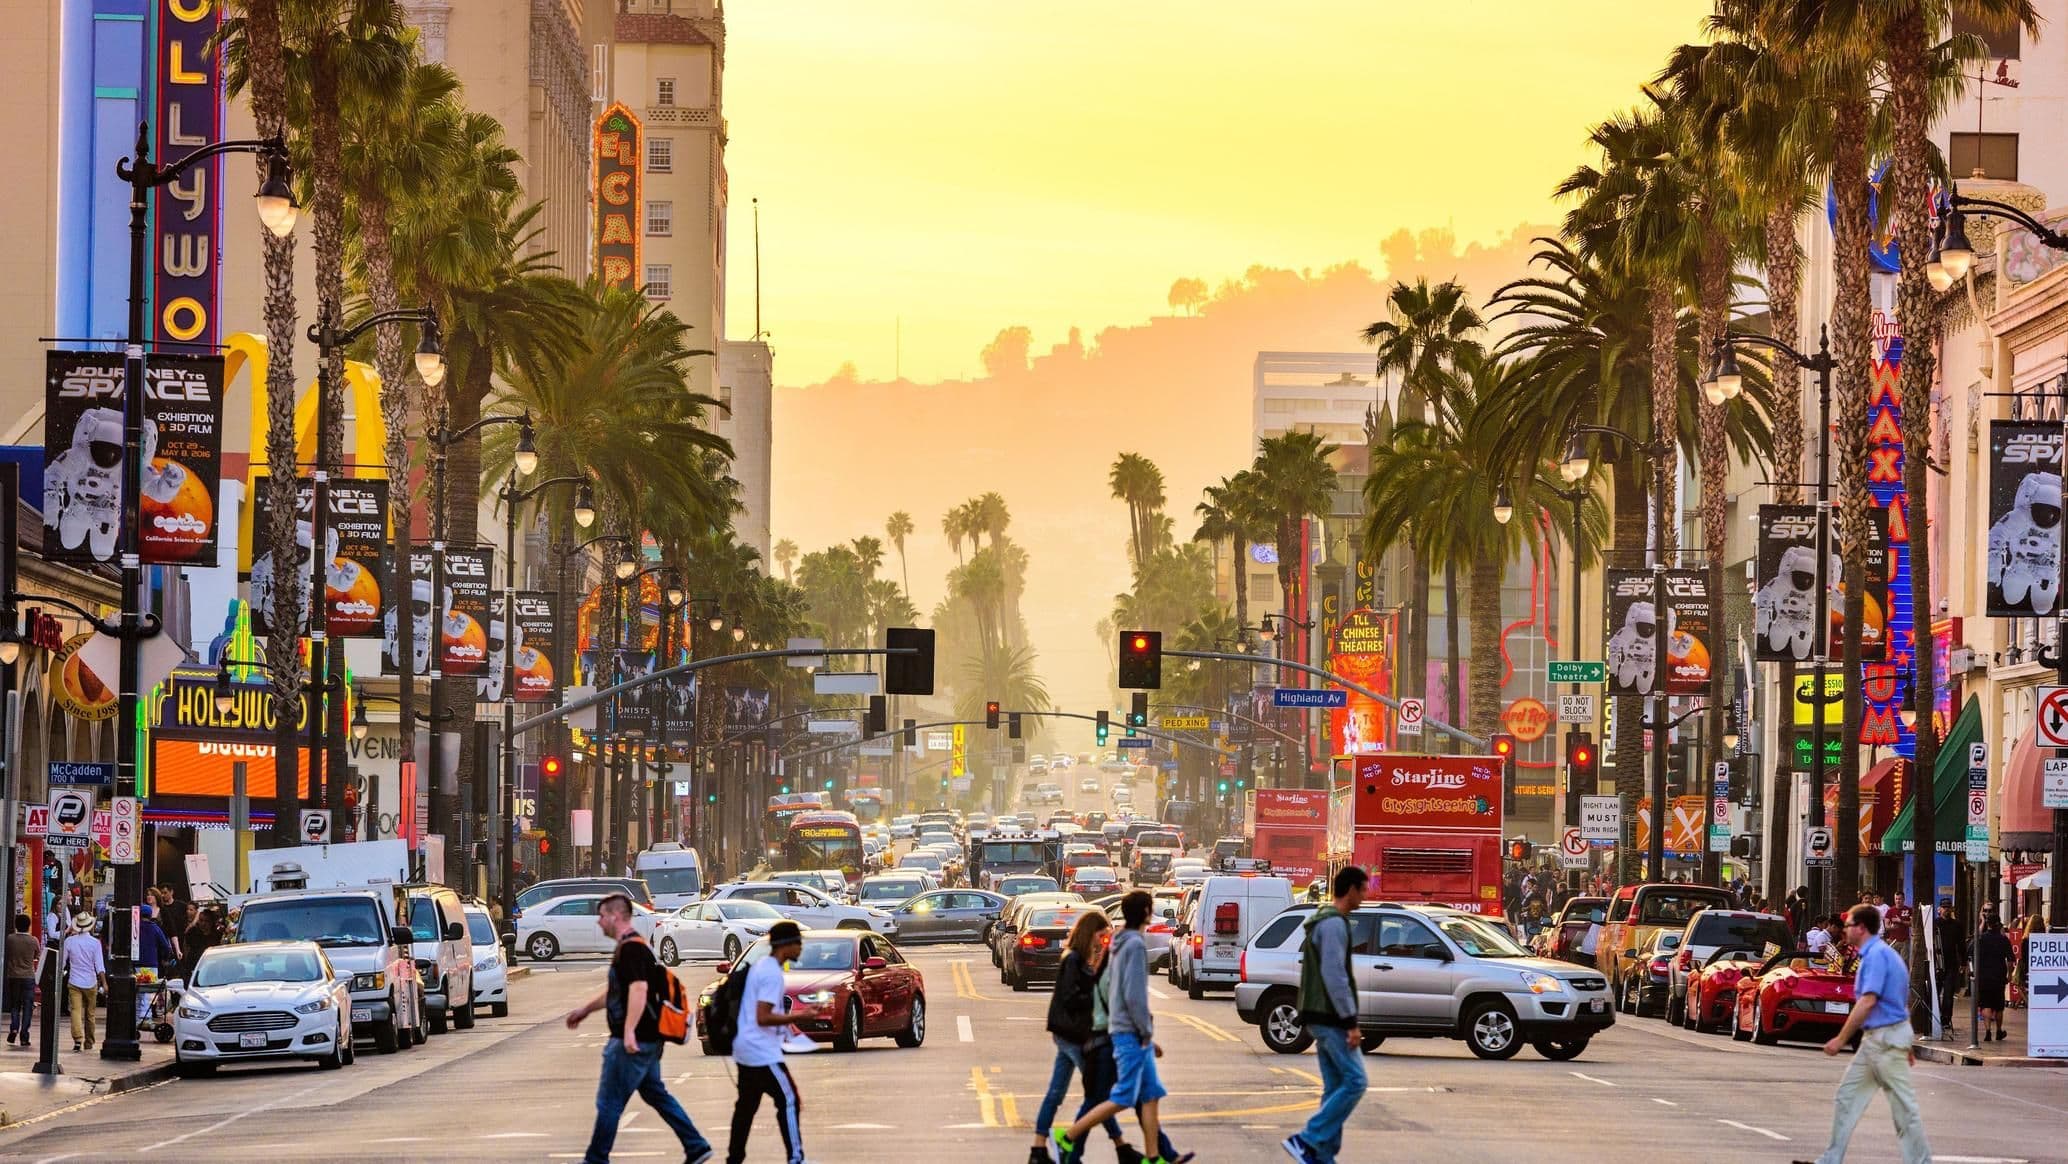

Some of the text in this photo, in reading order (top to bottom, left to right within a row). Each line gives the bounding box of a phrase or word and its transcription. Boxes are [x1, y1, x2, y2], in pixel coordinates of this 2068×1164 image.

[157, 412, 214, 423] EXHIBITION
[1868, 358, 1903, 482] WAX
[159, 423, 212, 434] & 3D FILM
[338, 522, 382, 531] EXHIBITION
[361, 532, 380, 540] FILM
[411, 561, 485, 576] PACE
[1353, 614, 1369, 625] TCL
[1342, 628, 1379, 639] CHINESE
[1339, 641, 1383, 652] THEATRES
[1557, 664, 1583, 673] Dolby
[1552, 673, 1588, 681] Theatre
[1280, 693, 1341, 704] Highland Av
[1563, 697, 1589, 706] DO NOT
[63, 699, 119, 719] Since 1989
[1564, 706, 1587, 714] BLOCK
[1165, 719, 1206, 727] PED XING
[1559, 714, 1592, 722] INTERSECTION
[51, 764, 102, 776] McCadden
[51, 775, 111, 783] 1700 N Pl
[28, 810, 48, 826] AT
[93, 811, 112, 826] AT
[50, 836, 86, 846] PAY HERE
[1565, 858, 1587, 866] ON RED
